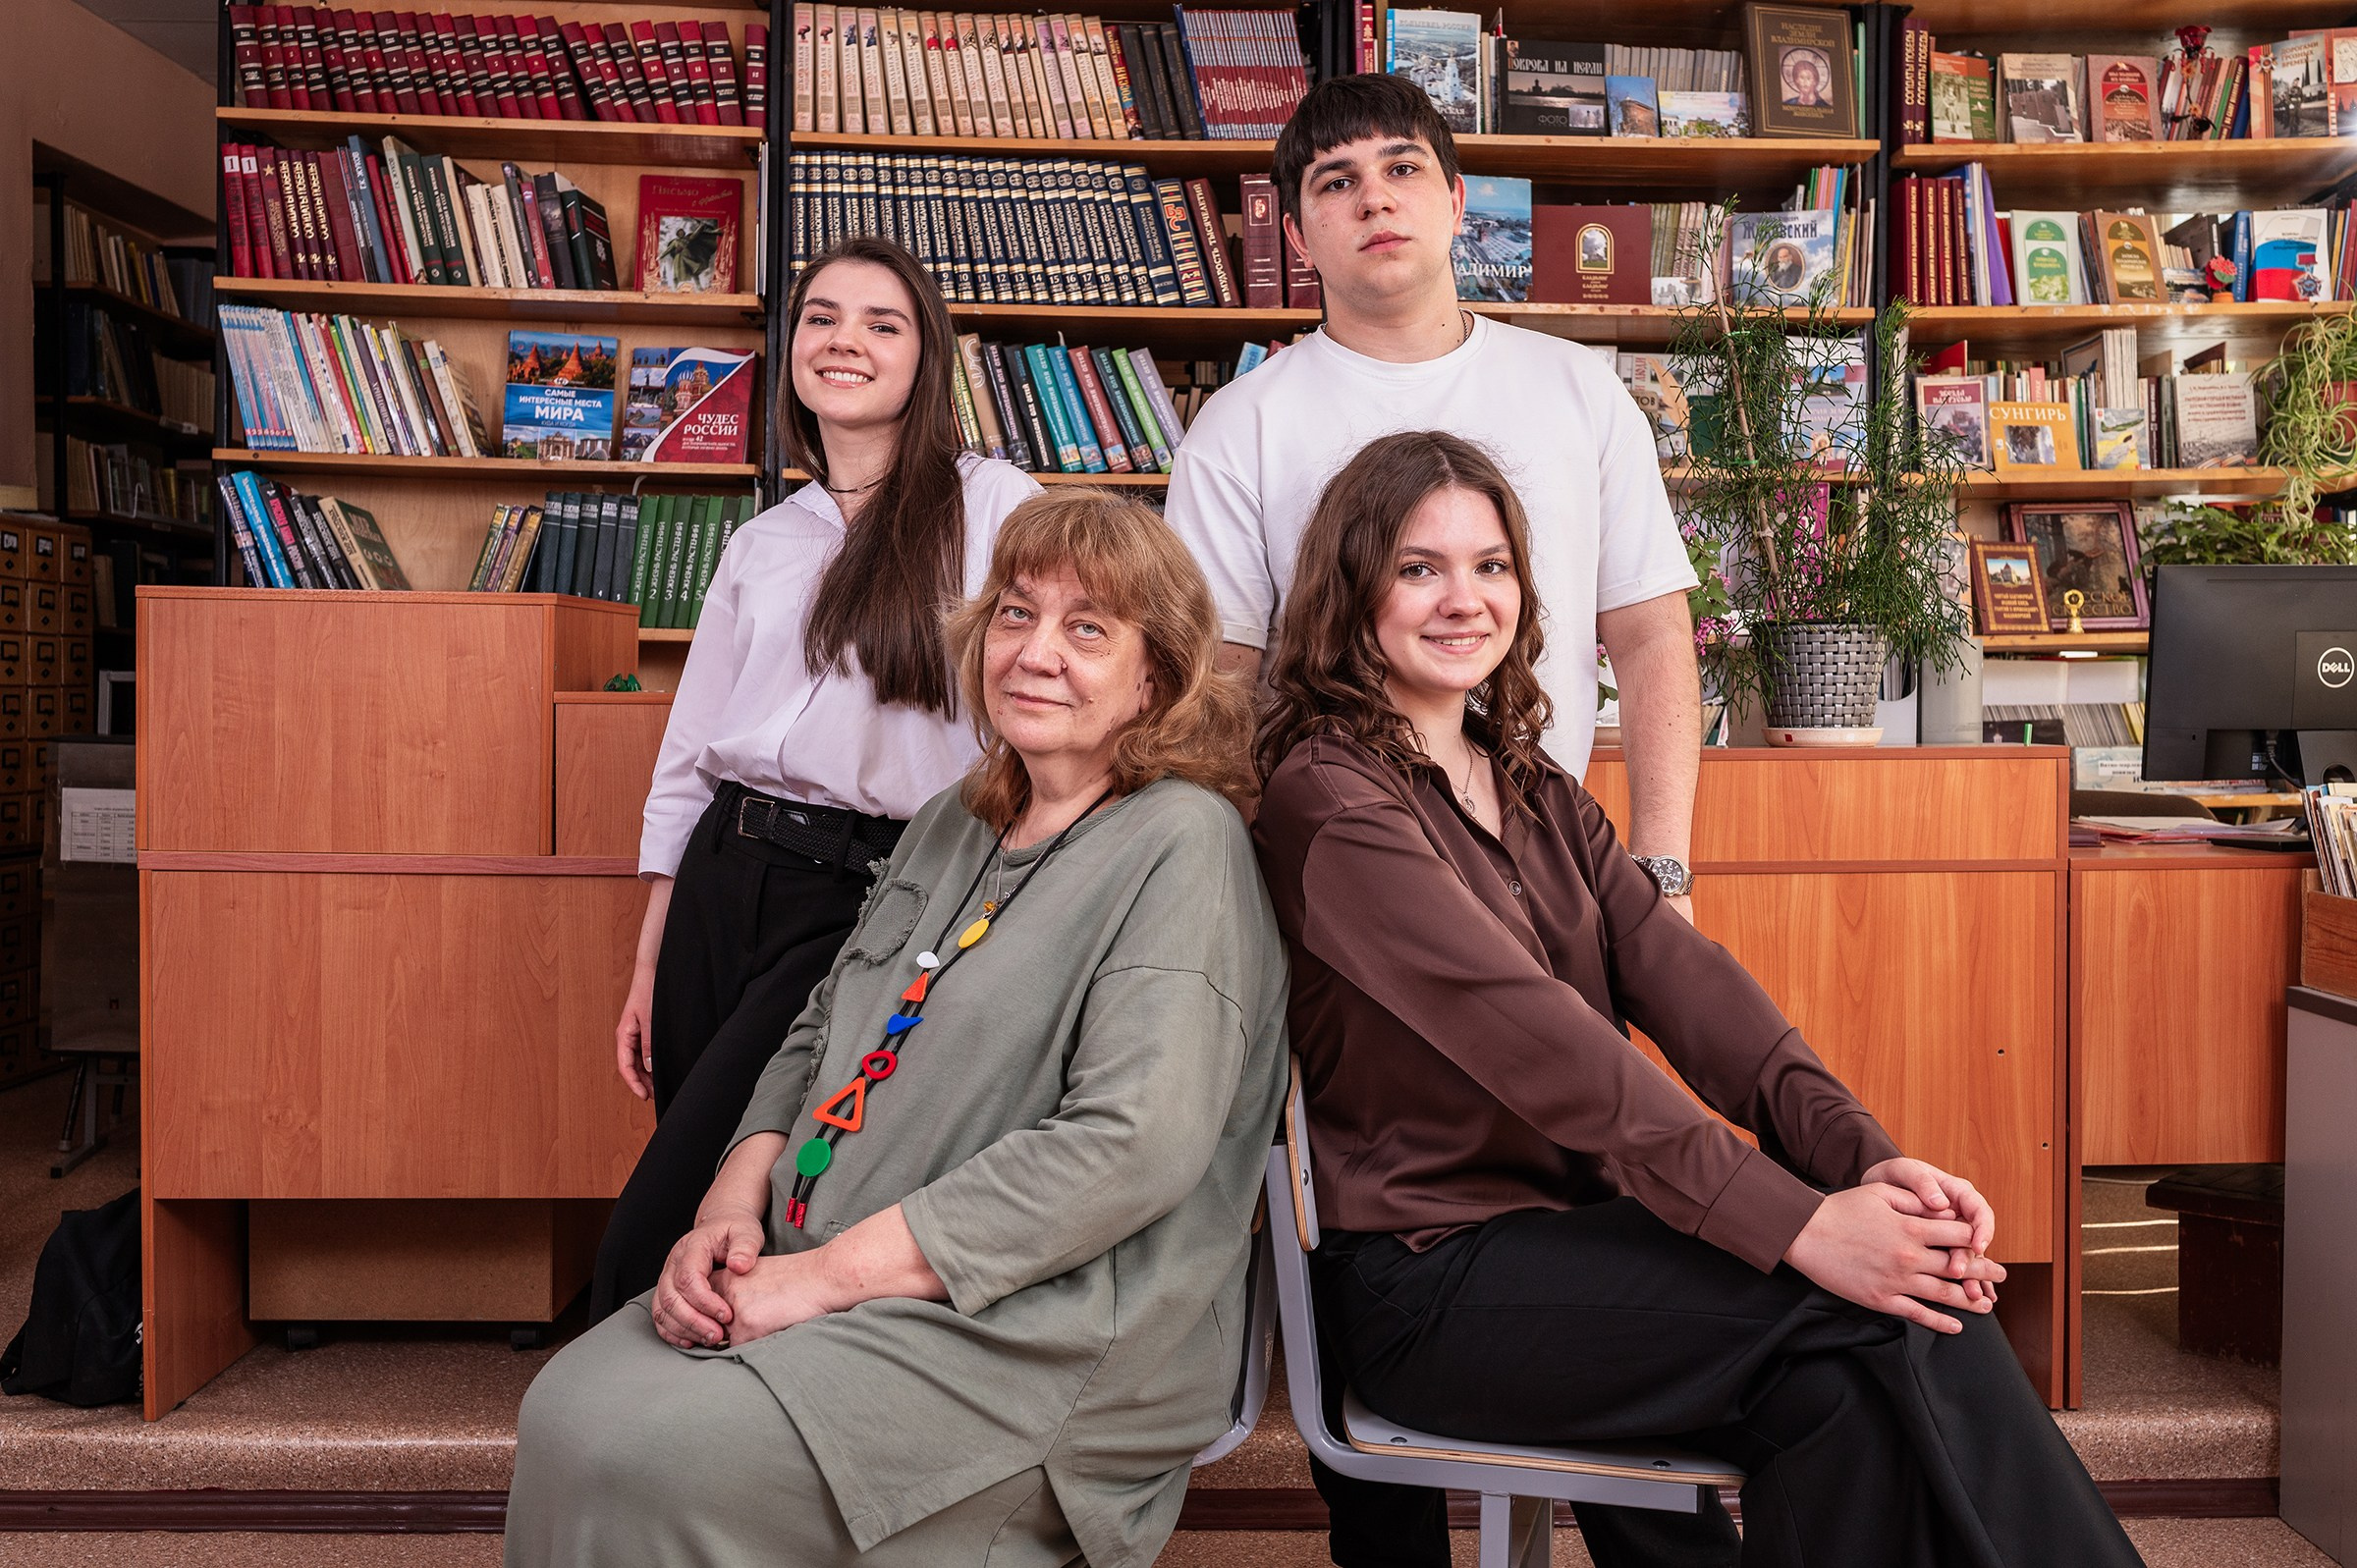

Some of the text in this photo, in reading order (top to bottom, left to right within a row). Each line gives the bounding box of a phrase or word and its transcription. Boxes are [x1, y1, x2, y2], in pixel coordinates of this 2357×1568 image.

[1554, 59, 1567, 73] НА
[1573, 61, 1603, 75] НЕРЛИ
[1116, 66, 1130, 104] РОССИЯ
[279, 160, 293, 193] ПОБЕДЫ
[292, 161, 306, 194] ПОБЕДЫ
[1003, 201, 1020, 257] ЭНЦИКЛОПЕДИЯ
[1144, 205, 1163, 260] ЭНЦИКЛОПЕДИЯ
[1742, 219, 1818, 239] ЖВСКИЙ
[1191, 183, 1231, 292] МУДРОСТЬ ТЫСЯЧЕЛЕТИЙ
[942, 272, 950, 281] 9
[959, 273, 968, 282] 10
[996, 273, 1007, 283] 12
[1031, 273, 1043, 283] 14
[1049, 274, 1060, 284] 15
[1066, 274, 1076, 284] 16
[1082, 272, 1092, 283] 17
[1100, 273, 1111, 283] 18
[1136, 275, 1147, 285] 20
[544, 388, 576, 399] САМЫЕ
[989, 345, 1019, 440] ЭНЦИКЛОПЕДИЯ ДЛЯ ДЕТЕЙ
[1035, 347, 1069, 441] ЭНЦИКЛОПЕДИЯ ДЛЯ ДЕТЕЙ
[1075, 351, 1113, 443] ЭНЦИКЛОПЕДИЯ ДЛЯ ДЕТЕЙ
[1099, 351, 1139, 444] ЭНЦИКЛОПЕДИЯ ДЛЯ ДЕТЕЙ
[1136, 352, 1180, 443] ЭНЦИКЛОПЕДИЯ ДЛЯ ДЕТЕЙ
[519, 395, 602, 408] ИНТЕРЕСНЫЕ МЕСТА
[534, 406, 584, 422] МИРА
[697, 412, 739, 425] ЧУДЕС
[1990, 406, 2066, 421] СУНГИРЬ
[683, 423, 739, 435] РОССИИ
[1021, 383, 1050, 466] ЭНЦИКЛОПЕДИЯ ДЛЯ ДЕТЕЙ
[635, 523, 650, 591] ЖИЗНЬ РАСТЕНИЙ
[651, 521, 666, 588] ЖИЗНЬ РАСТЕНИЙ
[667, 521, 684, 590] ЖИЗНЬ РАСТЕНИЙ
[683, 523, 700, 591] ЖИЗНЬ РАСТЕНИЙ
[699, 522, 716, 588] ЖИЗНЬ РАСТЕНИЙ
[633, 592, 639, 602] 1
[648, 589, 657, 599] 2
[665, 589, 673, 601] 3
[681, 590, 688, 601] 4
[694, 590, 702, 600] 5
[2322, 662, 2350, 673] DELL
